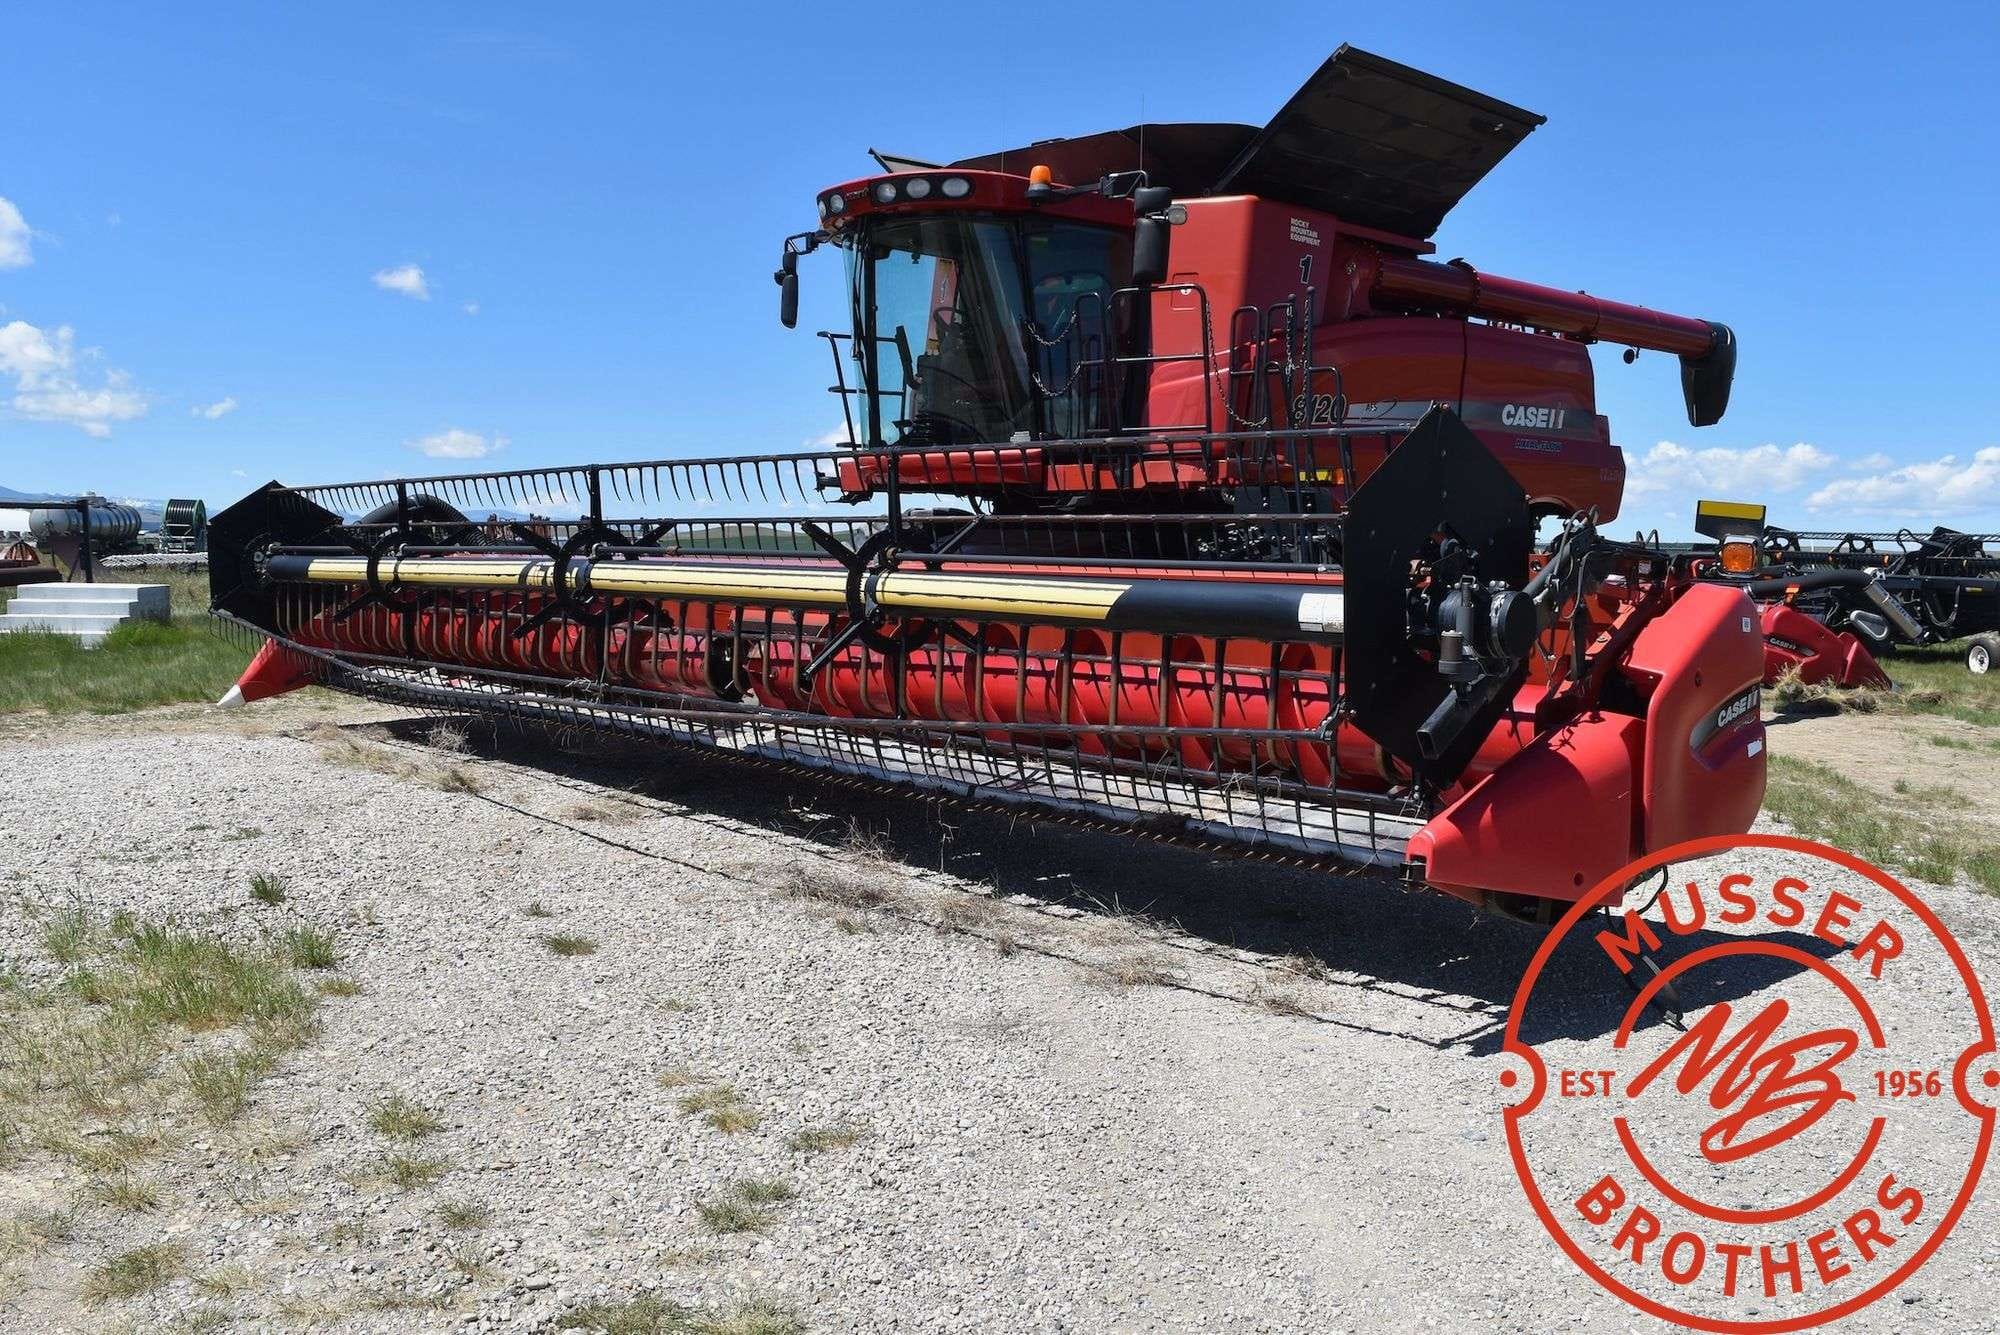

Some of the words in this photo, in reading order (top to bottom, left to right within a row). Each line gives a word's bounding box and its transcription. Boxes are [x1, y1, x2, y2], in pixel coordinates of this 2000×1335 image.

[1290, 216, 1310, 228] ROCKY
[1290, 225, 1319, 238] MOUNTAIN
[1290, 232, 1321, 246] EQUIPMENT
[1299, 253, 1313, 285] 1
